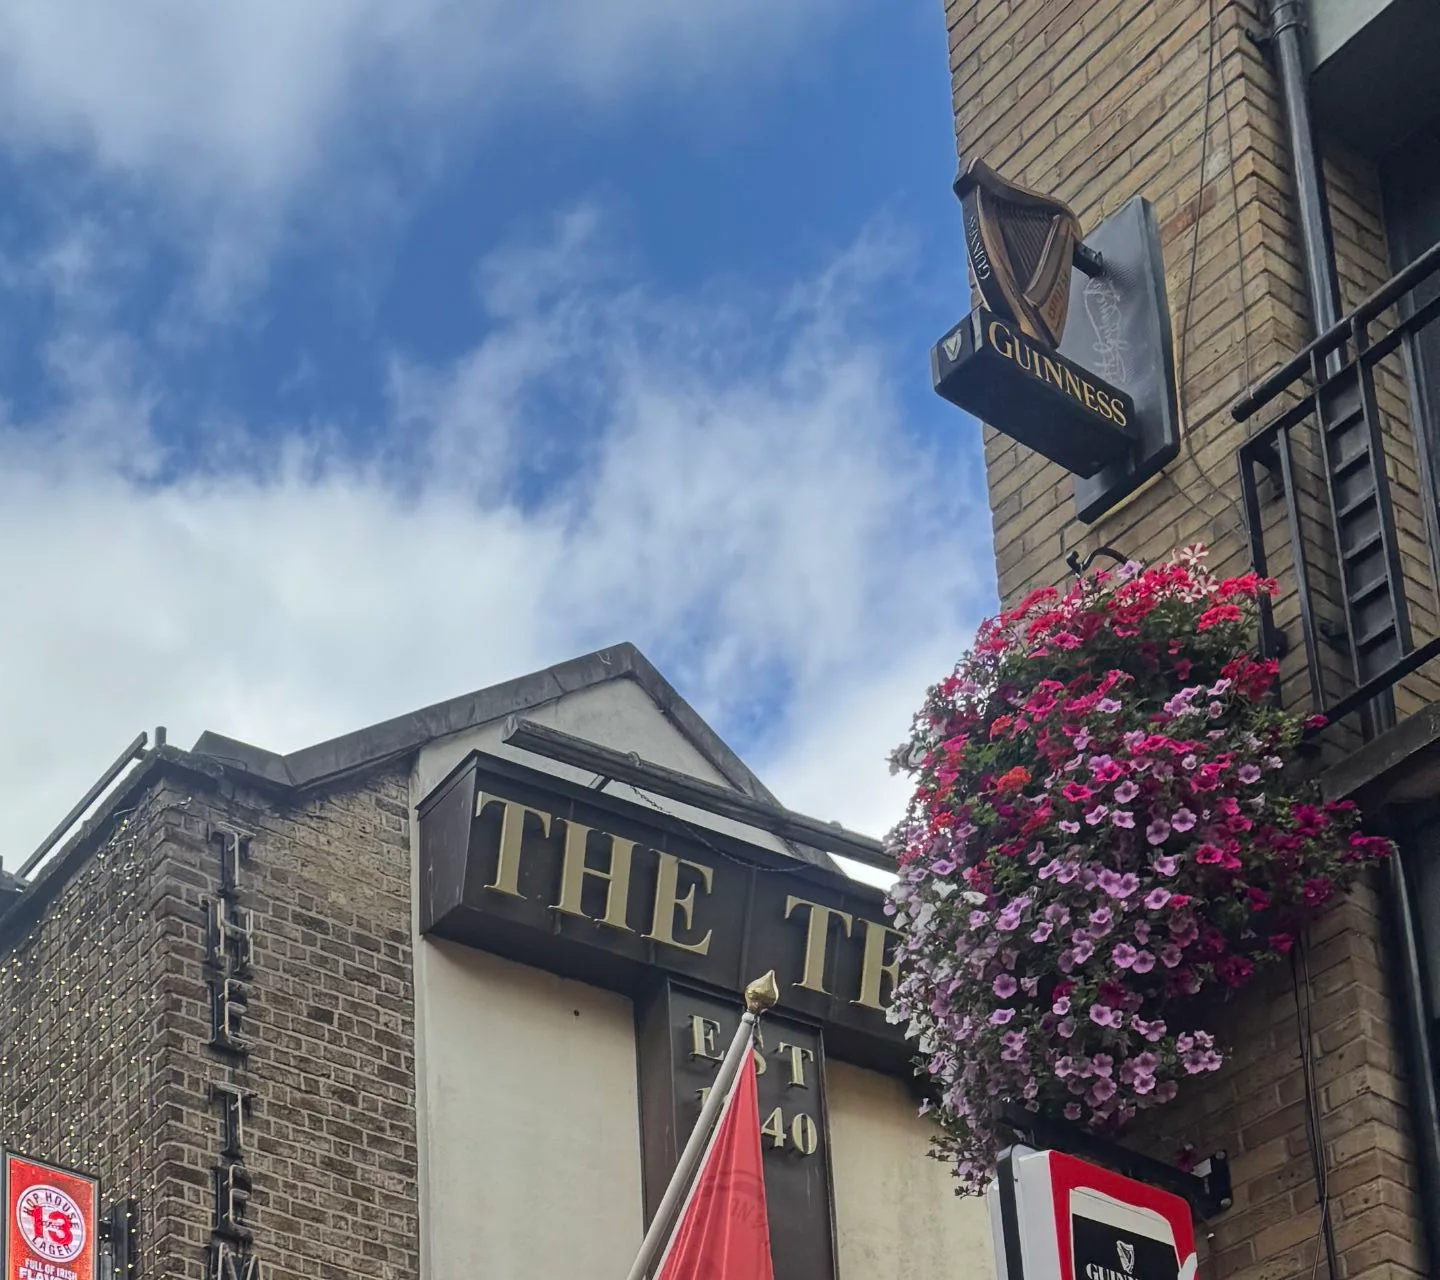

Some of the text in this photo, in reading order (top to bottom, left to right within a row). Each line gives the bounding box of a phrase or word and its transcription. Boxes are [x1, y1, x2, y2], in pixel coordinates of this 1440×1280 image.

[989, 321, 1127, 427] GUINNESS
[476, 790, 715, 956] THE
[22, 1191, 80, 1231] HOP HOUSE
[32, 1204, 73, 1245] 13
[32, 1235, 73, 1256] LAGER
